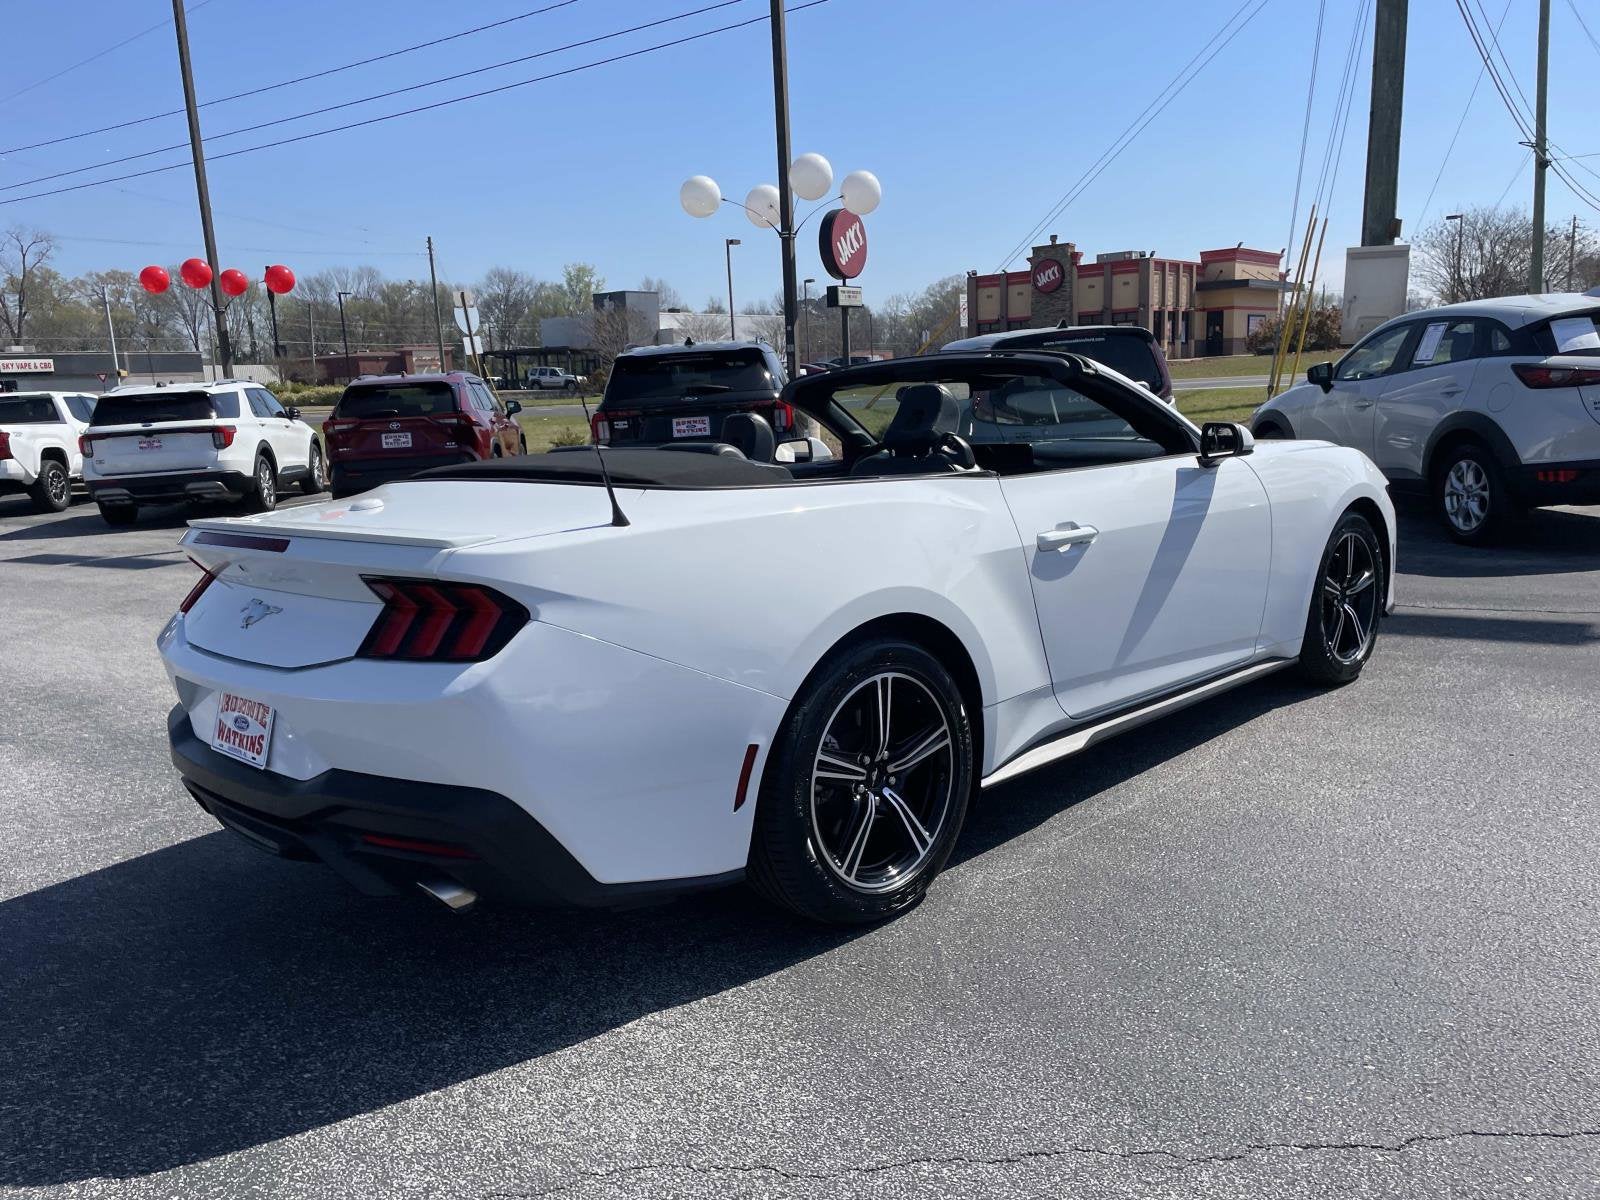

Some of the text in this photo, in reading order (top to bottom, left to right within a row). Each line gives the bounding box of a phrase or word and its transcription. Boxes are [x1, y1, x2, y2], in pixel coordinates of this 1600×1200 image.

[1, 362, 14, 370] SKY
[15, 362, 32, 370] VAPE
[217, 718, 264, 756] WATKINS
